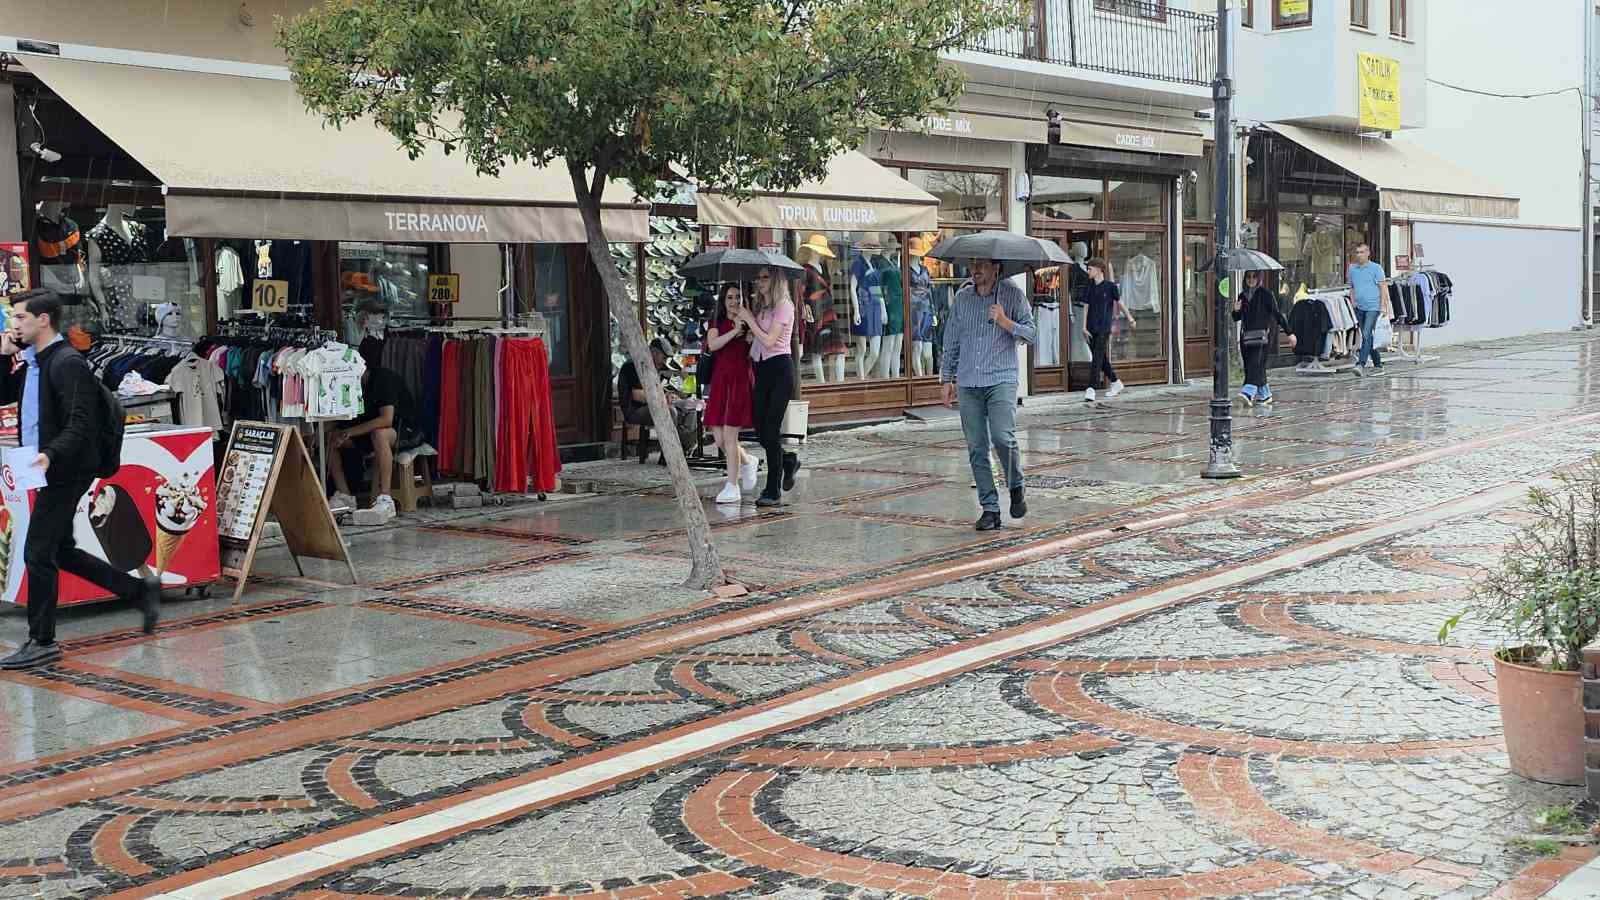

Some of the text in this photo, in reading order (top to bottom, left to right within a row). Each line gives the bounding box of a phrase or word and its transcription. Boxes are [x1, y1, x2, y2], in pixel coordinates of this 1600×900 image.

[384, 212, 488, 233] TERRANOVA
[778, 204, 879, 225] TOPUK KUNDURA
